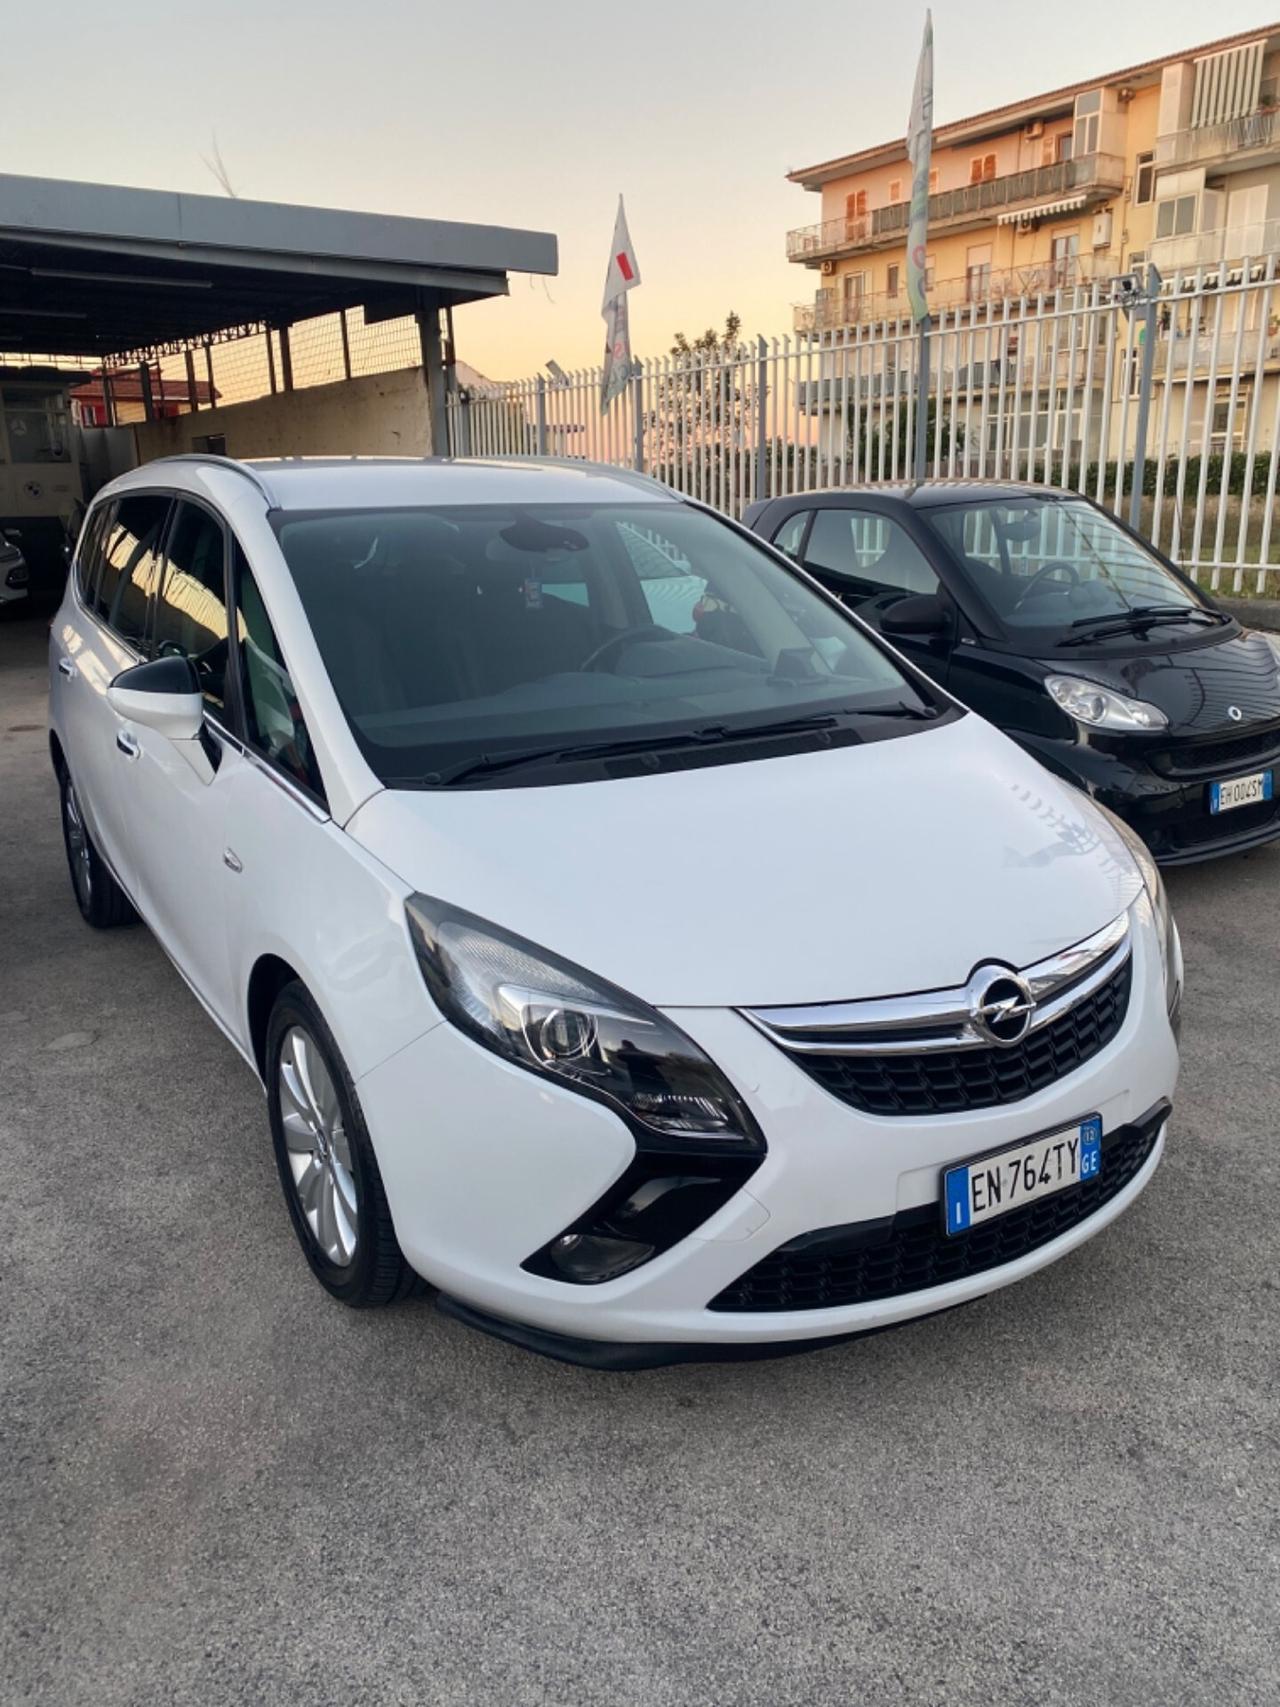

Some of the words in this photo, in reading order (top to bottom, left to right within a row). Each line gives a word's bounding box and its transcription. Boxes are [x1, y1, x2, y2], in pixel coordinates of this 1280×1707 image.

[1085, 1130, 1096, 1142] 12
[1081, 1150, 1098, 1174] GE
[971, 1166, 1002, 1213] EN
[1008, 1137, 1079, 1199] 764TY
[956, 1202, 962, 1224] I
